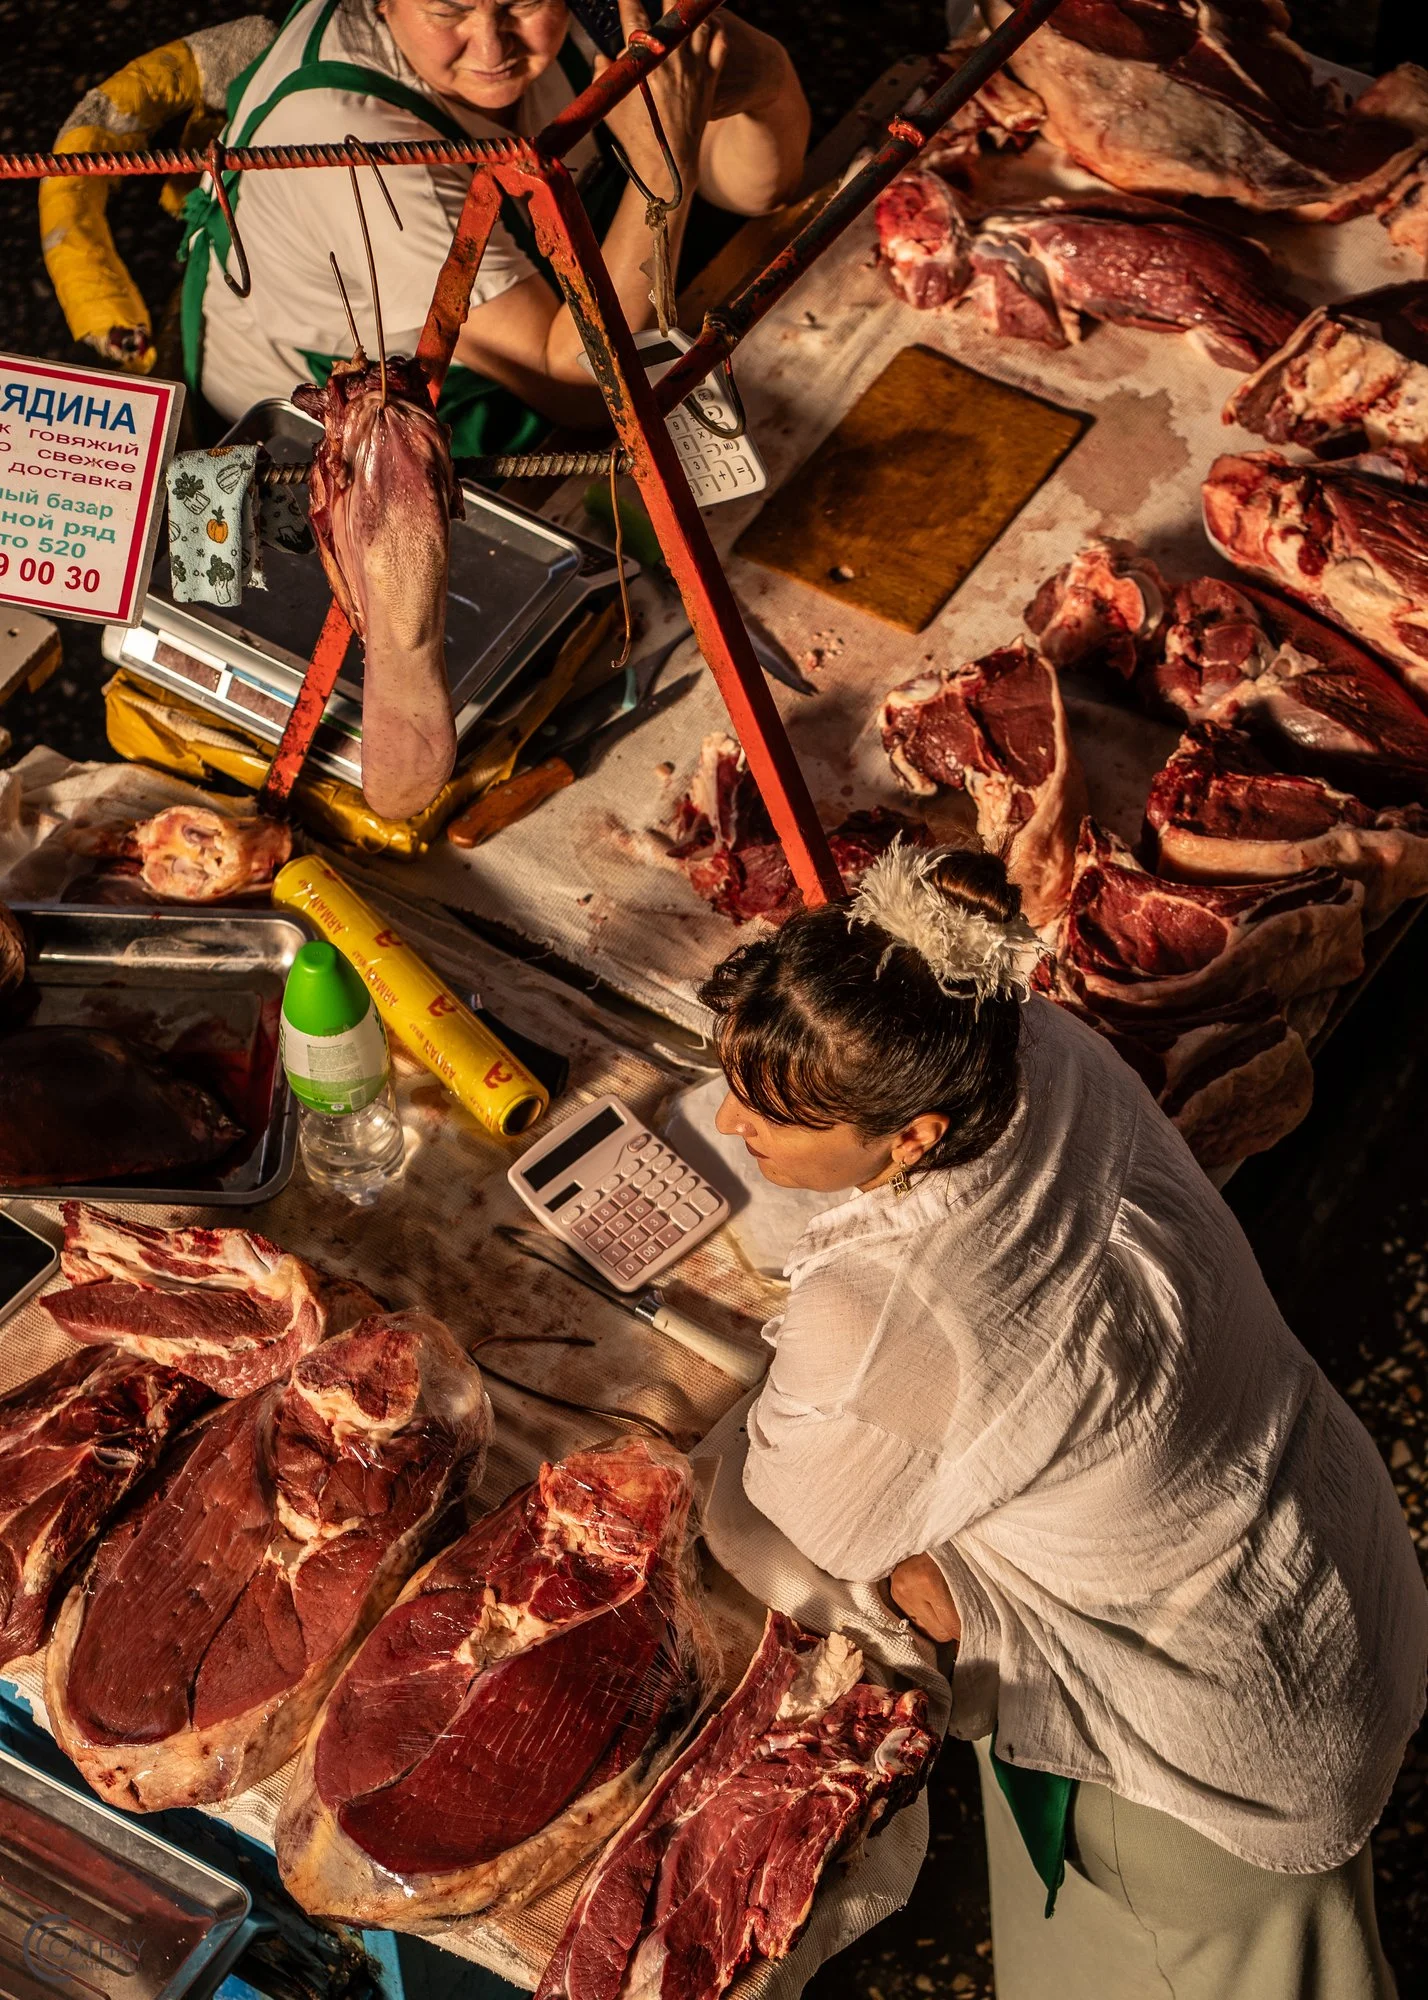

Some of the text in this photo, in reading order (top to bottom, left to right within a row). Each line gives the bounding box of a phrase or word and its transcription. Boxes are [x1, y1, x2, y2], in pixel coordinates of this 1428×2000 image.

[0, 383, 137, 435] ЯДИНА
[29, 428, 139, 457] говяжий
[8, 462, 132, 491] доставка
[37, 448, 136, 474] свежее
[0, 487, 113, 520] ый базар
[2, 511, 116, 544] ной ряд
[38, 537, 86, 559] 520
[20, 557, 55, 585] 00
[64, 565, 101, 593] 30
[308, 896, 345, 936] ARMAN
[365, 966, 399, 1008] ARMAN
[642, 1245, 656, 1257] 00
